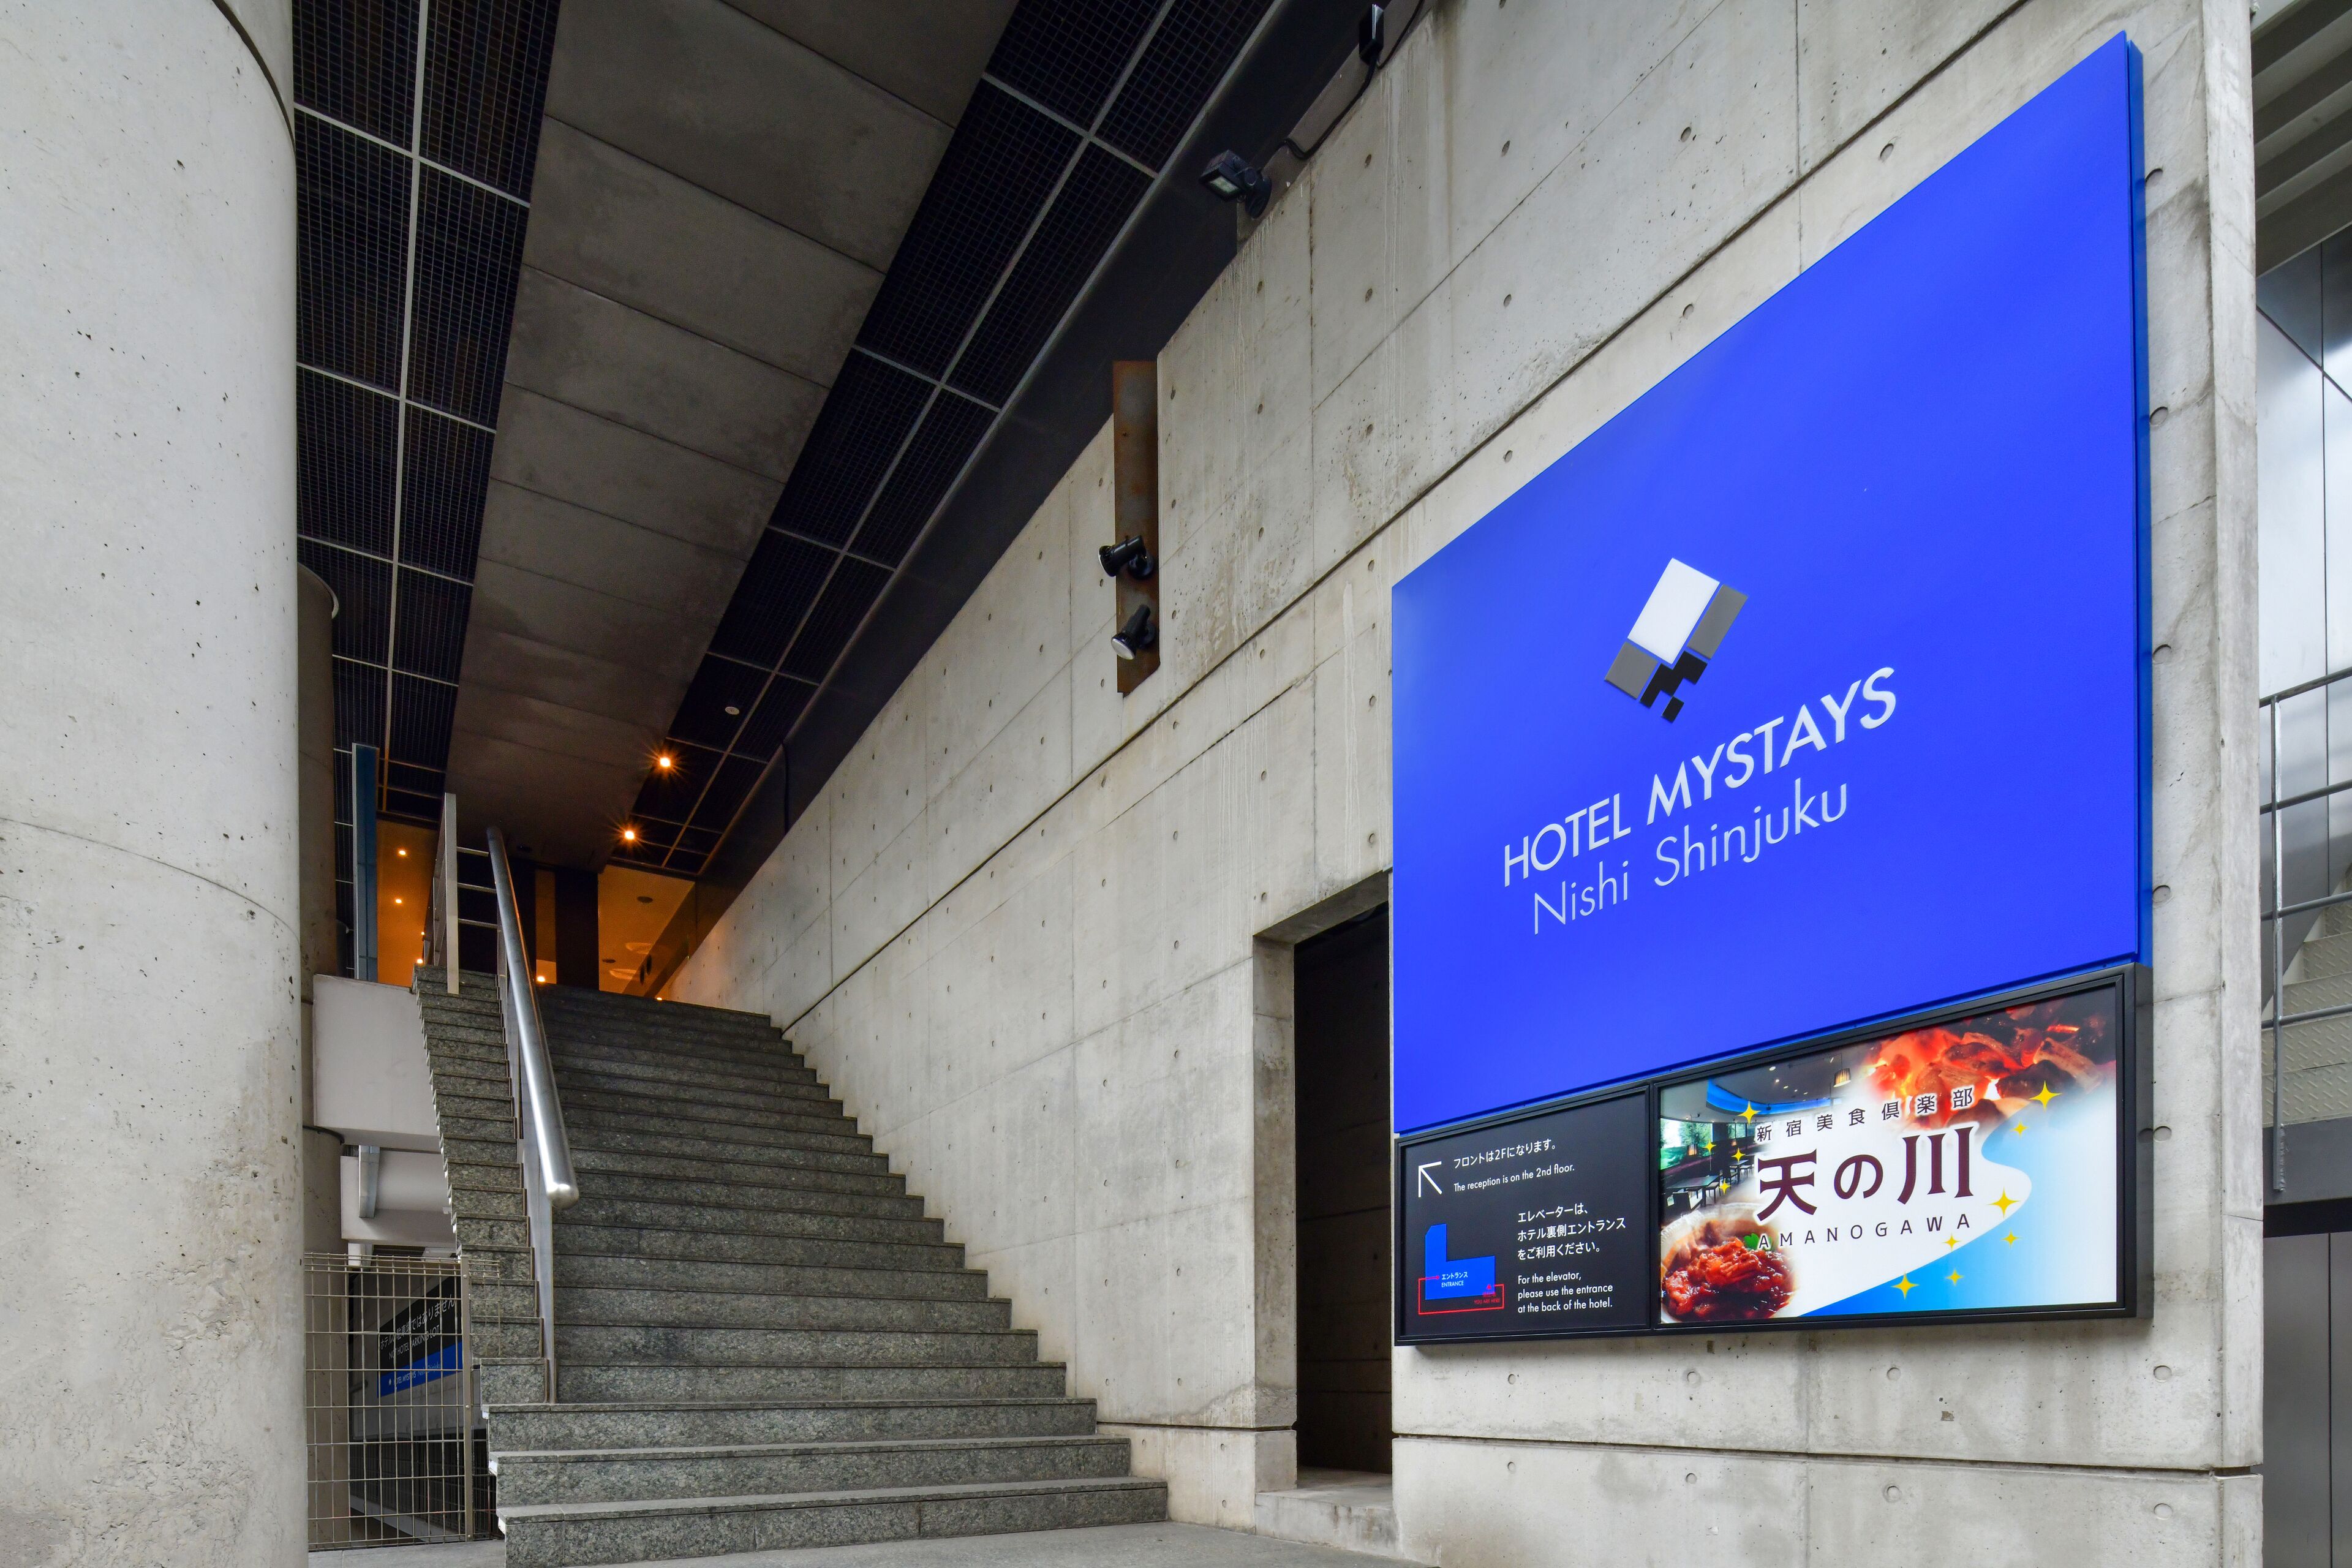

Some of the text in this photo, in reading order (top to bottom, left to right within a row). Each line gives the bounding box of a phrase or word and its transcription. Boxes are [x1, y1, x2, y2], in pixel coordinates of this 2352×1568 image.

[1504, 666, 1896, 888] HOTEL MYSTAYS
[1534, 777, 1848, 935] Nishi Shinjuku
[1757, 1087, 1973, 1142] 新宿美食倶楽部
[1453, 1138, 1556, 1169] フロントは2Fになります。
[1453, 1164, 1575, 1192] The reception is on the 2nd floor.
[1757, 1126, 1975, 1222] 天の川
[1518, 1202, 1588, 1223] エレベーターは、
[1517, 1218, 1626, 1242] ホテル裏側エントランス
[1758, 1213, 1970, 1249] AMANOGAWA
[1517, 1242, 1600, 1261] をご利用ください。
[1441, 1271, 1468, 1280] エントランス
[1518, 1272, 1582, 1284] For the elevator,
[1518, 1289, 1544, 1301] please
[1561, 1285, 1574, 1295] the
[1576, 1284, 1613, 1294] entrance
[1518, 1297, 1613, 1313] at the back of the hotel.
[397, 1342, 409, 1355] HOTEL
[410, 1331, 429, 1348] ARKING
